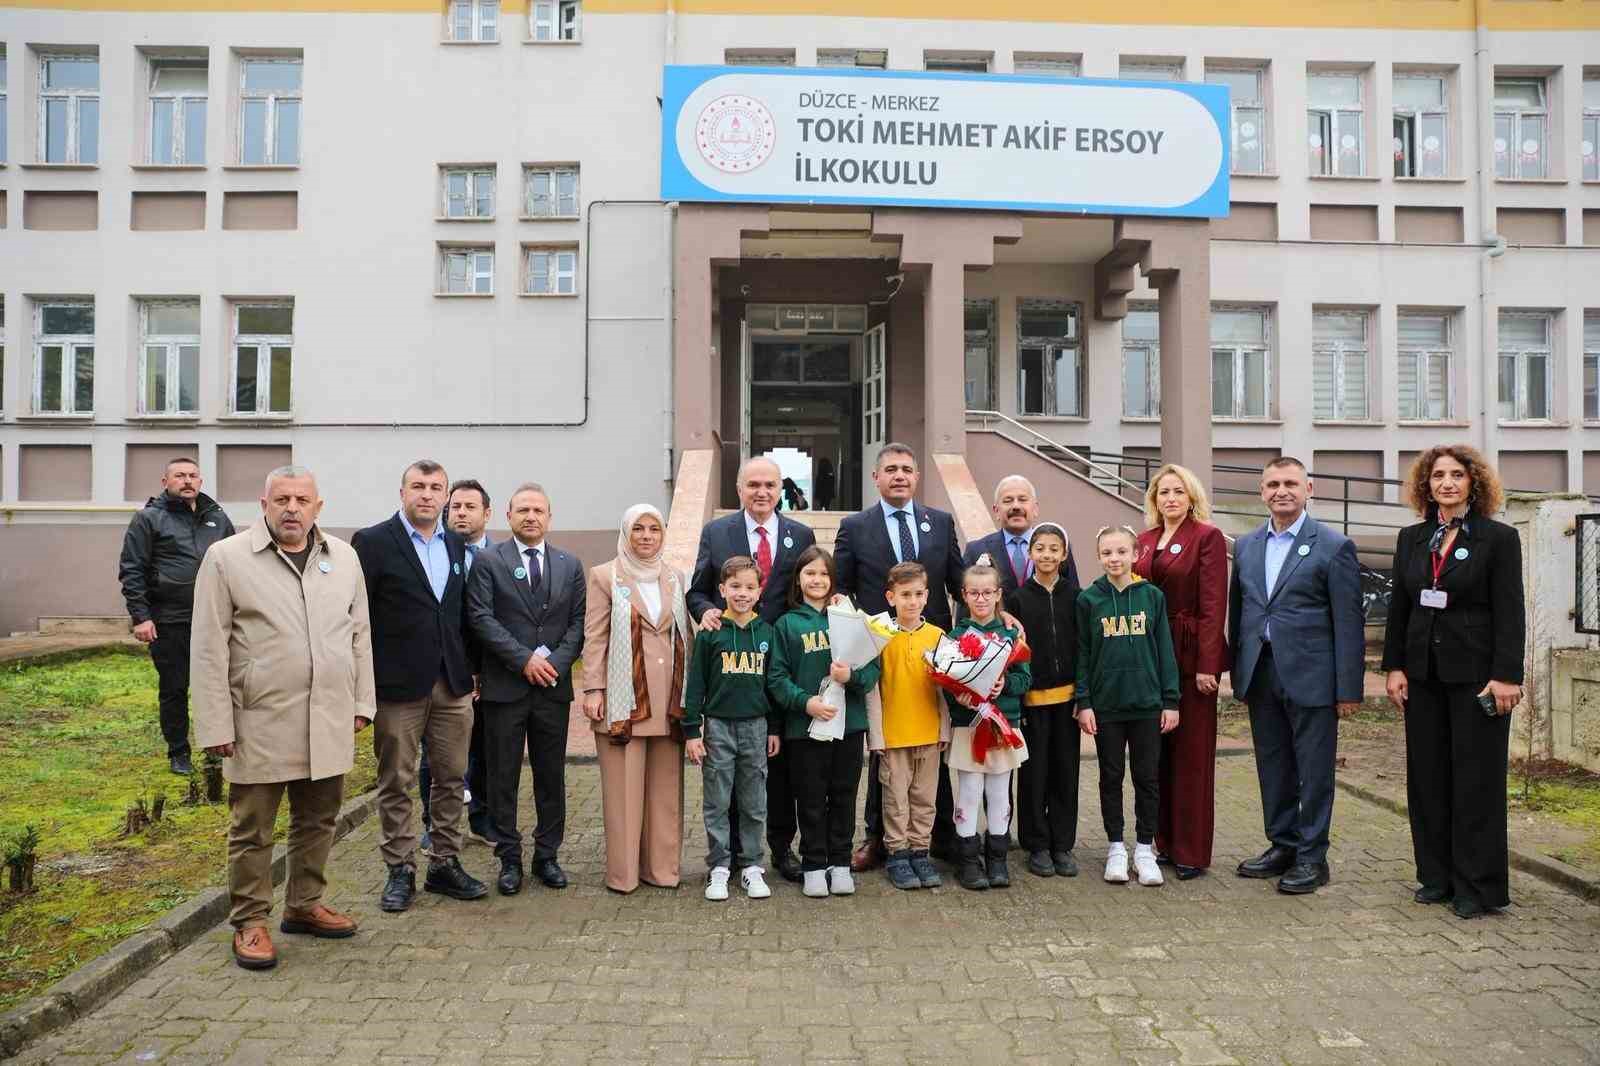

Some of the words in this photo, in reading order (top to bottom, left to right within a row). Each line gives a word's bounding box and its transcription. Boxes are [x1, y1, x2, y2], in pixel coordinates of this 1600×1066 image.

[799, 90, 857, 109] DÜZCE
[872, 95, 940, 111] MERKEZ
[796, 113, 864, 144] TOKİ
[872, 120, 998, 148] MEHMET
[1002, 120, 1067, 151] AKİF
[1075, 127, 1164, 155] ERSOY
[795, 152, 937, 185] İLKOKULU
[800, 630, 831, 653] MA
